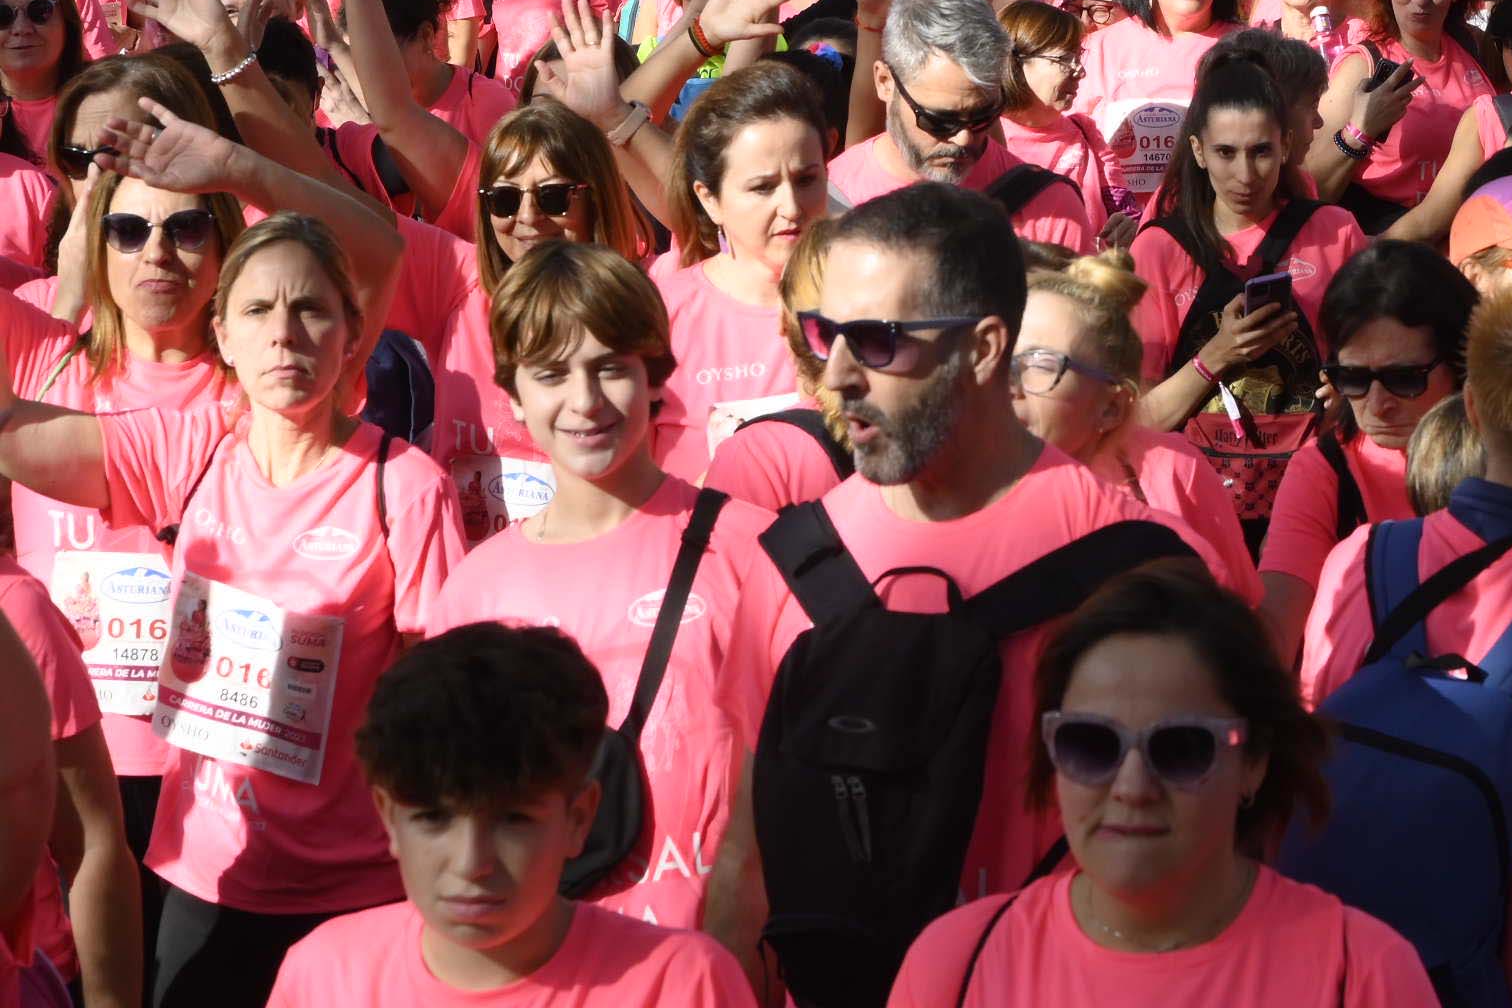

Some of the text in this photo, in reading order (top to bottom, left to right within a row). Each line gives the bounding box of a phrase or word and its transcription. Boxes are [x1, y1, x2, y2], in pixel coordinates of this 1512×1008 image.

[1136, 114, 1177, 123] ASTURIANA
[1140, 136, 1175, 148] 016
[696, 363, 766, 384] OYSHO
[453, 420, 494, 455] TU
[50, 510, 95, 549] TU
[108, 618, 167, 640] 016
[113, 648, 159, 661] 14878
[131, 669, 144, 678] LA
[216, 656, 270, 689] 016
[220, 689, 258, 709] 8486
[169, 695, 213, 716] CARRERA
[216, 709, 232, 720] DE
[232, 713, 245, 725] LA
[255, 743, 306, 766] Santander
